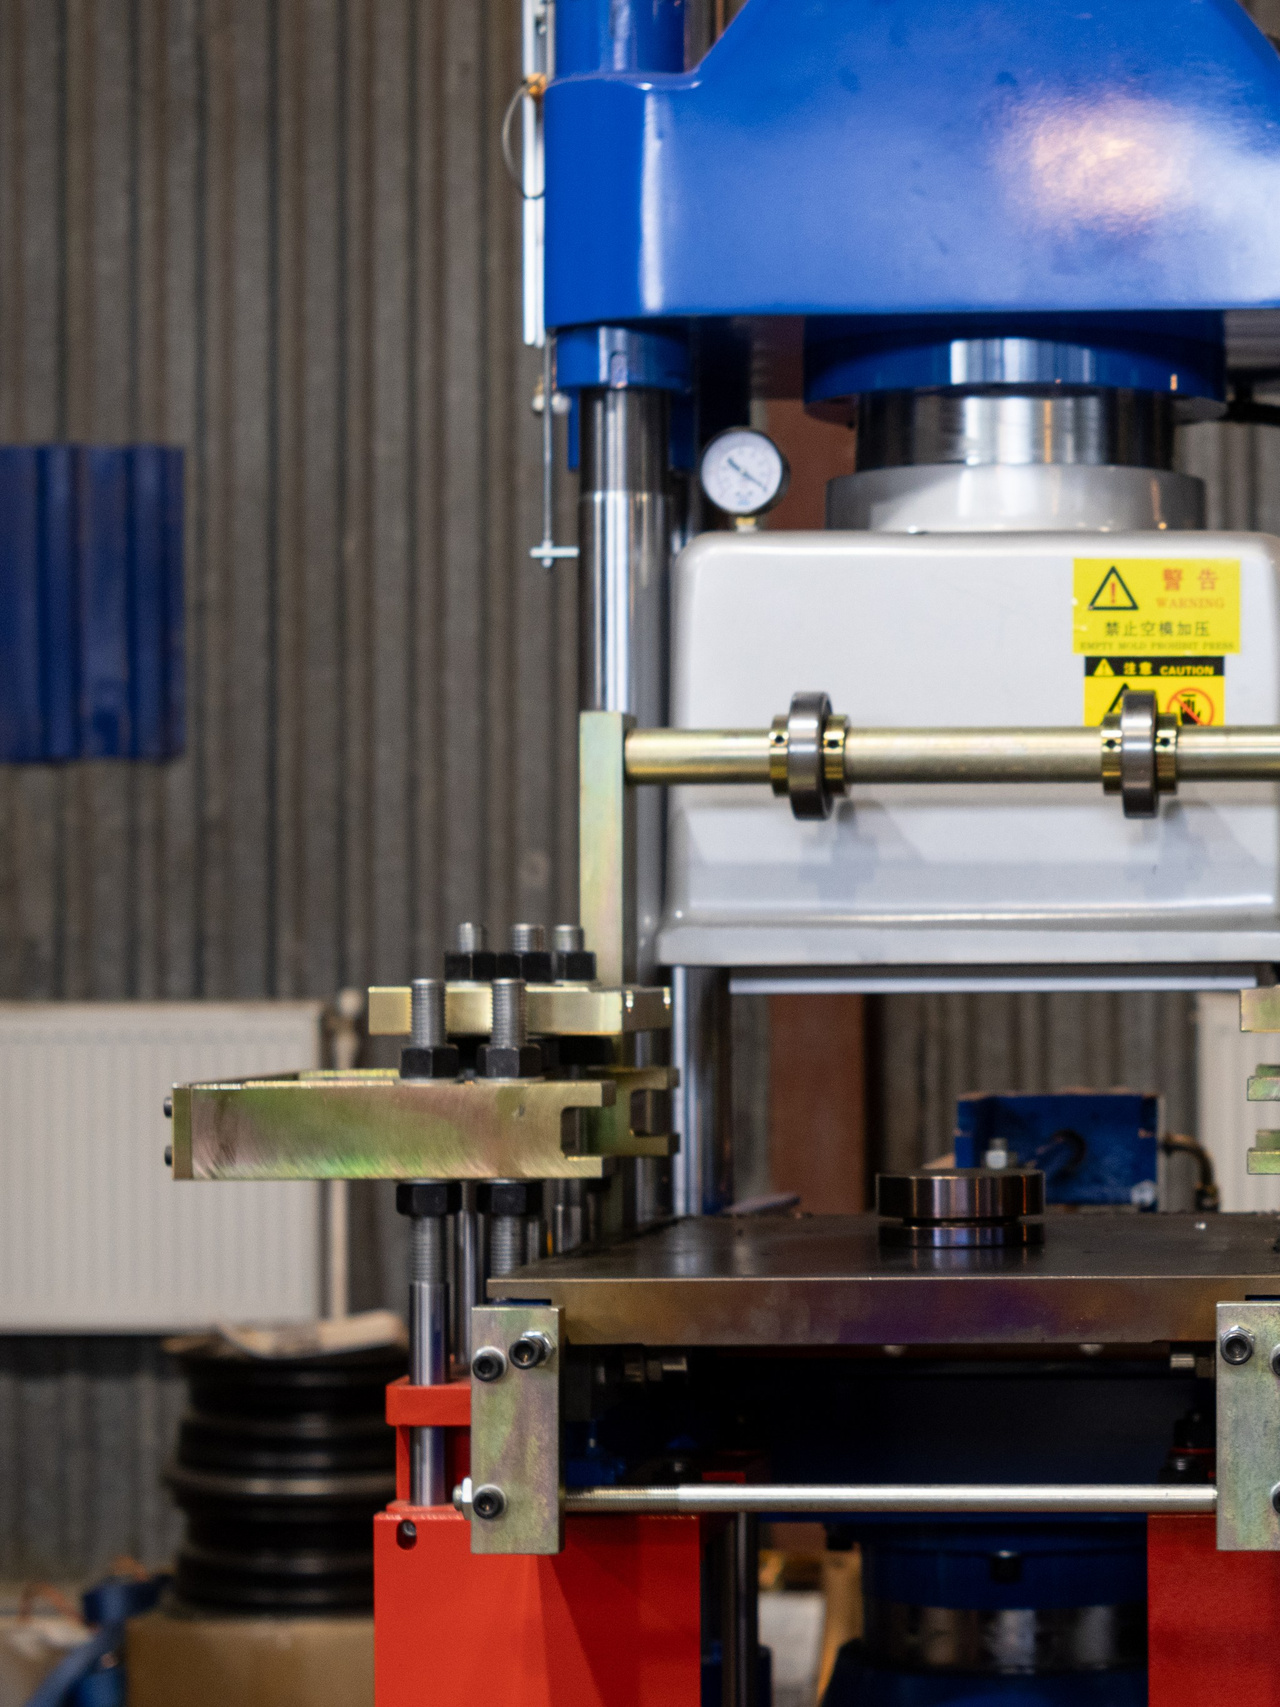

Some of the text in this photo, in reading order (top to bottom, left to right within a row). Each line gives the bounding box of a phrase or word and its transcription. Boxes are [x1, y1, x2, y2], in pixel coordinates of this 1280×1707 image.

[1162, 568, 1218, 592] 警告
[1156, 598, 1225, 609] WARNING
[1080, 641, 1234, 650] EMPTY MOLD PROHIBIT PRESS
[1123, 661, 1215, 676] 注意 CAUTION
